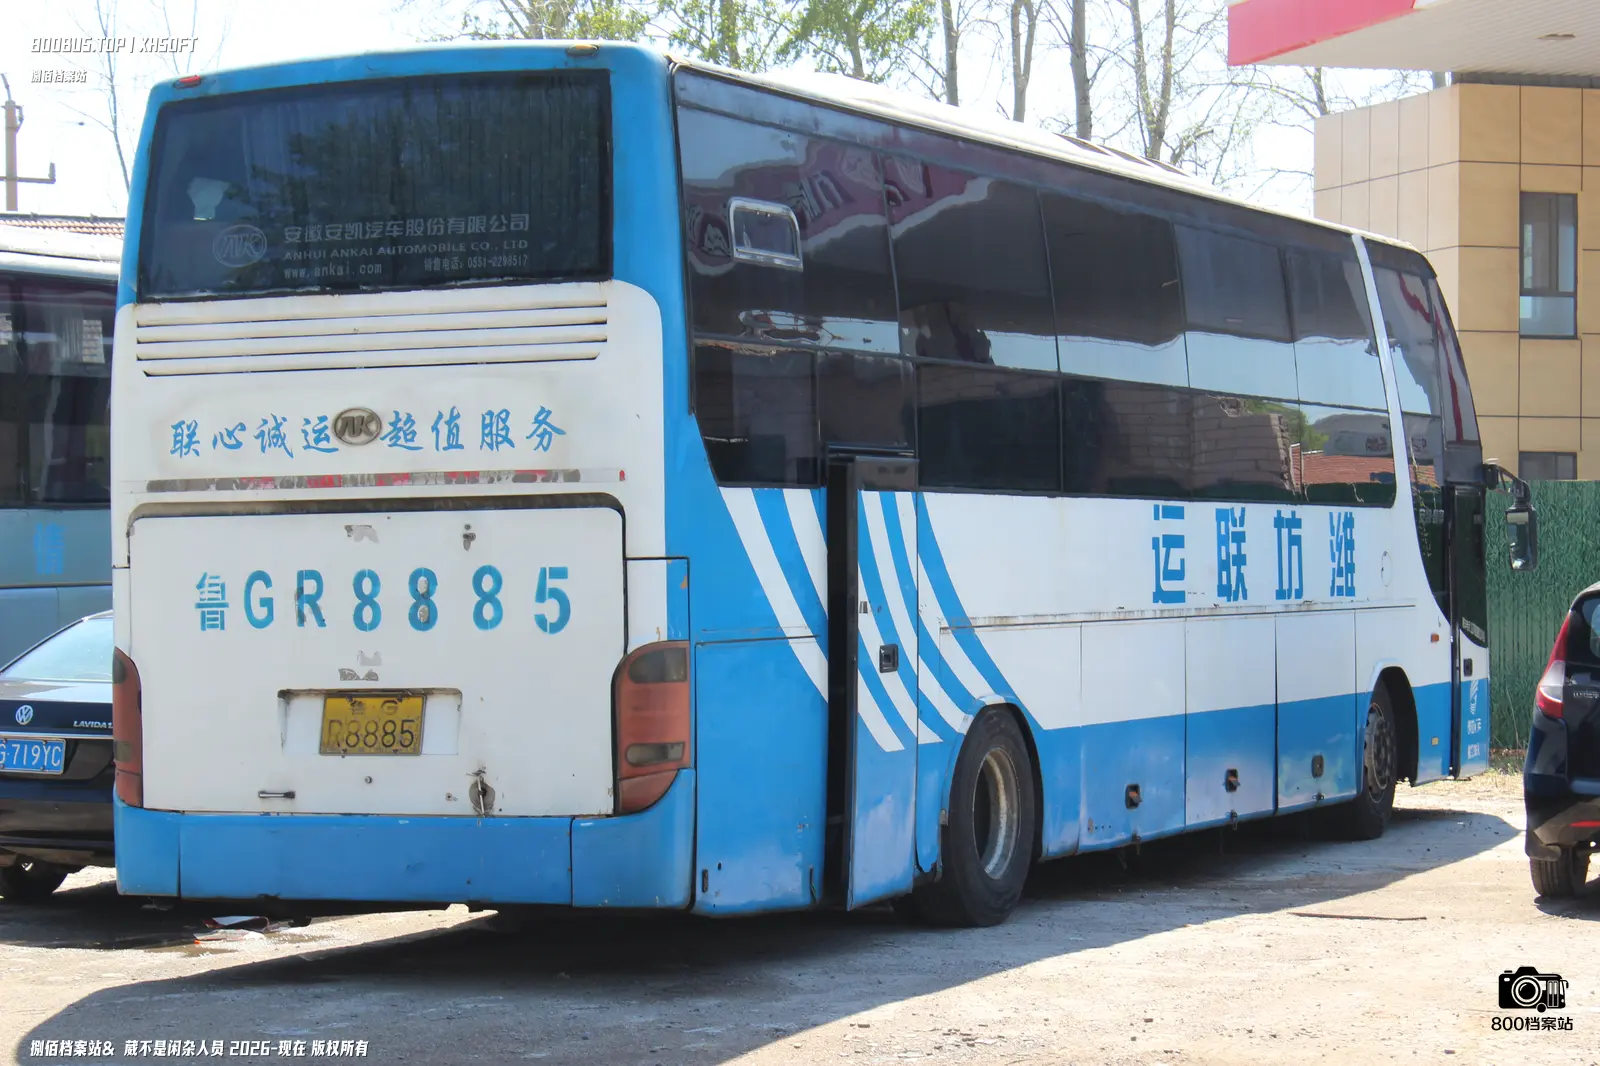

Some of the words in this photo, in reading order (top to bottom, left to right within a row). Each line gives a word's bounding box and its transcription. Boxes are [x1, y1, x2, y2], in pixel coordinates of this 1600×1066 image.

[284, 213, 530, 244] 安徽安凯汽车股份有限公司
[283, 249, 329, 261] ANHUI
[330, 247, 373, 259] ANKAI
[376, 243, 467, 256] AUTOMOBILE
[503, 239, 529, 250] LTD
[283, 262, 383, 279] www.ankai.com
[169, 413, 341, 458] 联心诚运
[379, 404, 567, 453] 超值服务
[327, 719, 416, 749] R8885
